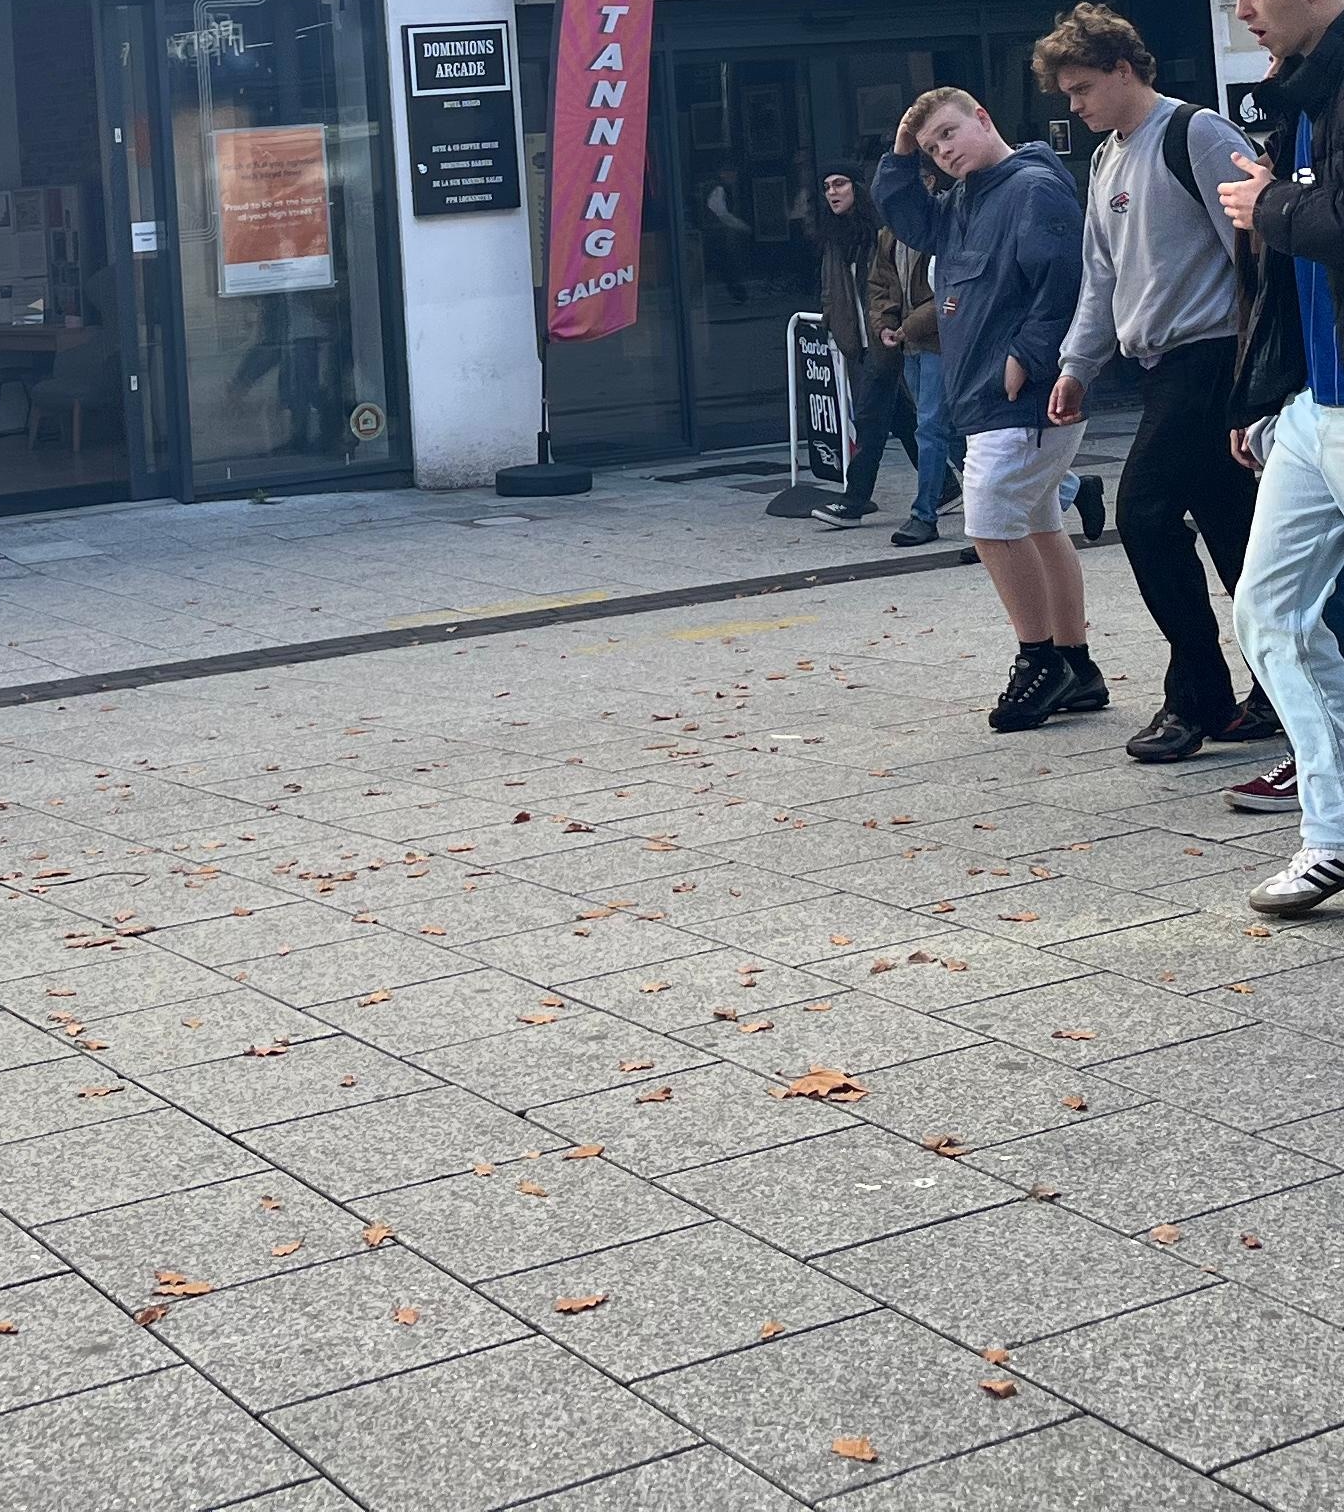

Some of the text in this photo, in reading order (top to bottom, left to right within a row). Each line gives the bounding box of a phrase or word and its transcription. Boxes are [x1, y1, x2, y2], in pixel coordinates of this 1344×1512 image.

[423, 40, 494, 58] DOMINIONS
[436, 61, 486, 78] ARCADE
[584, 5, 630, 258] TANNING
[556, 264, 635, 307] SALON
[799, 336, 830, 356] Barber
[806, 358, 831, 387] Shop
[809, 392, 838, 434] OPEN
